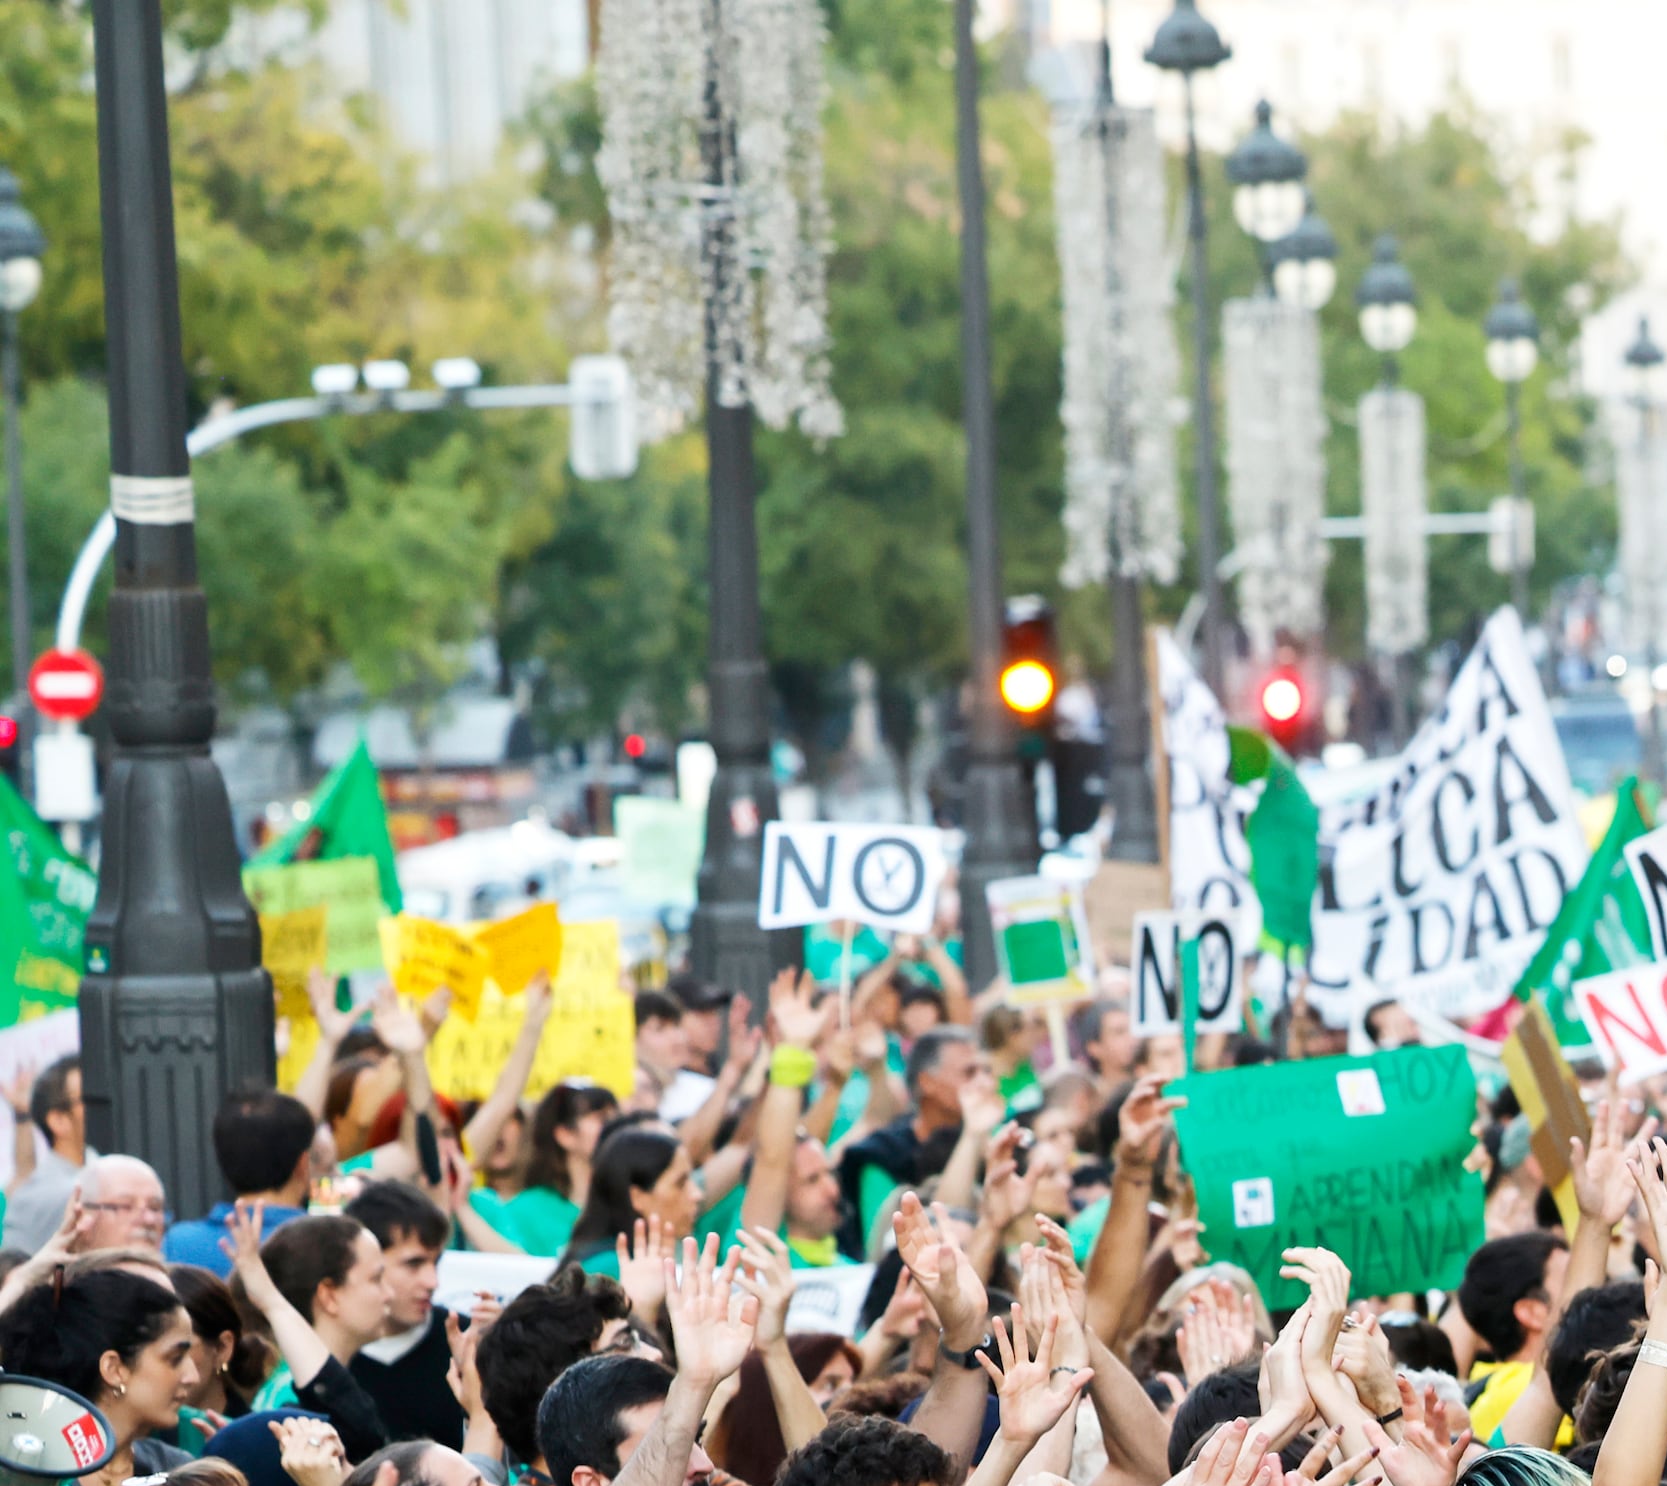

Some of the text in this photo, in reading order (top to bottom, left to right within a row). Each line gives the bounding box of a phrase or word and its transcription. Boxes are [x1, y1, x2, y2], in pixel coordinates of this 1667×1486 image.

[773, 835, 925, 916] NO
[1140, 918, 1233, 1023] NO
[1373, 1047, 1463, 1104] HOY
